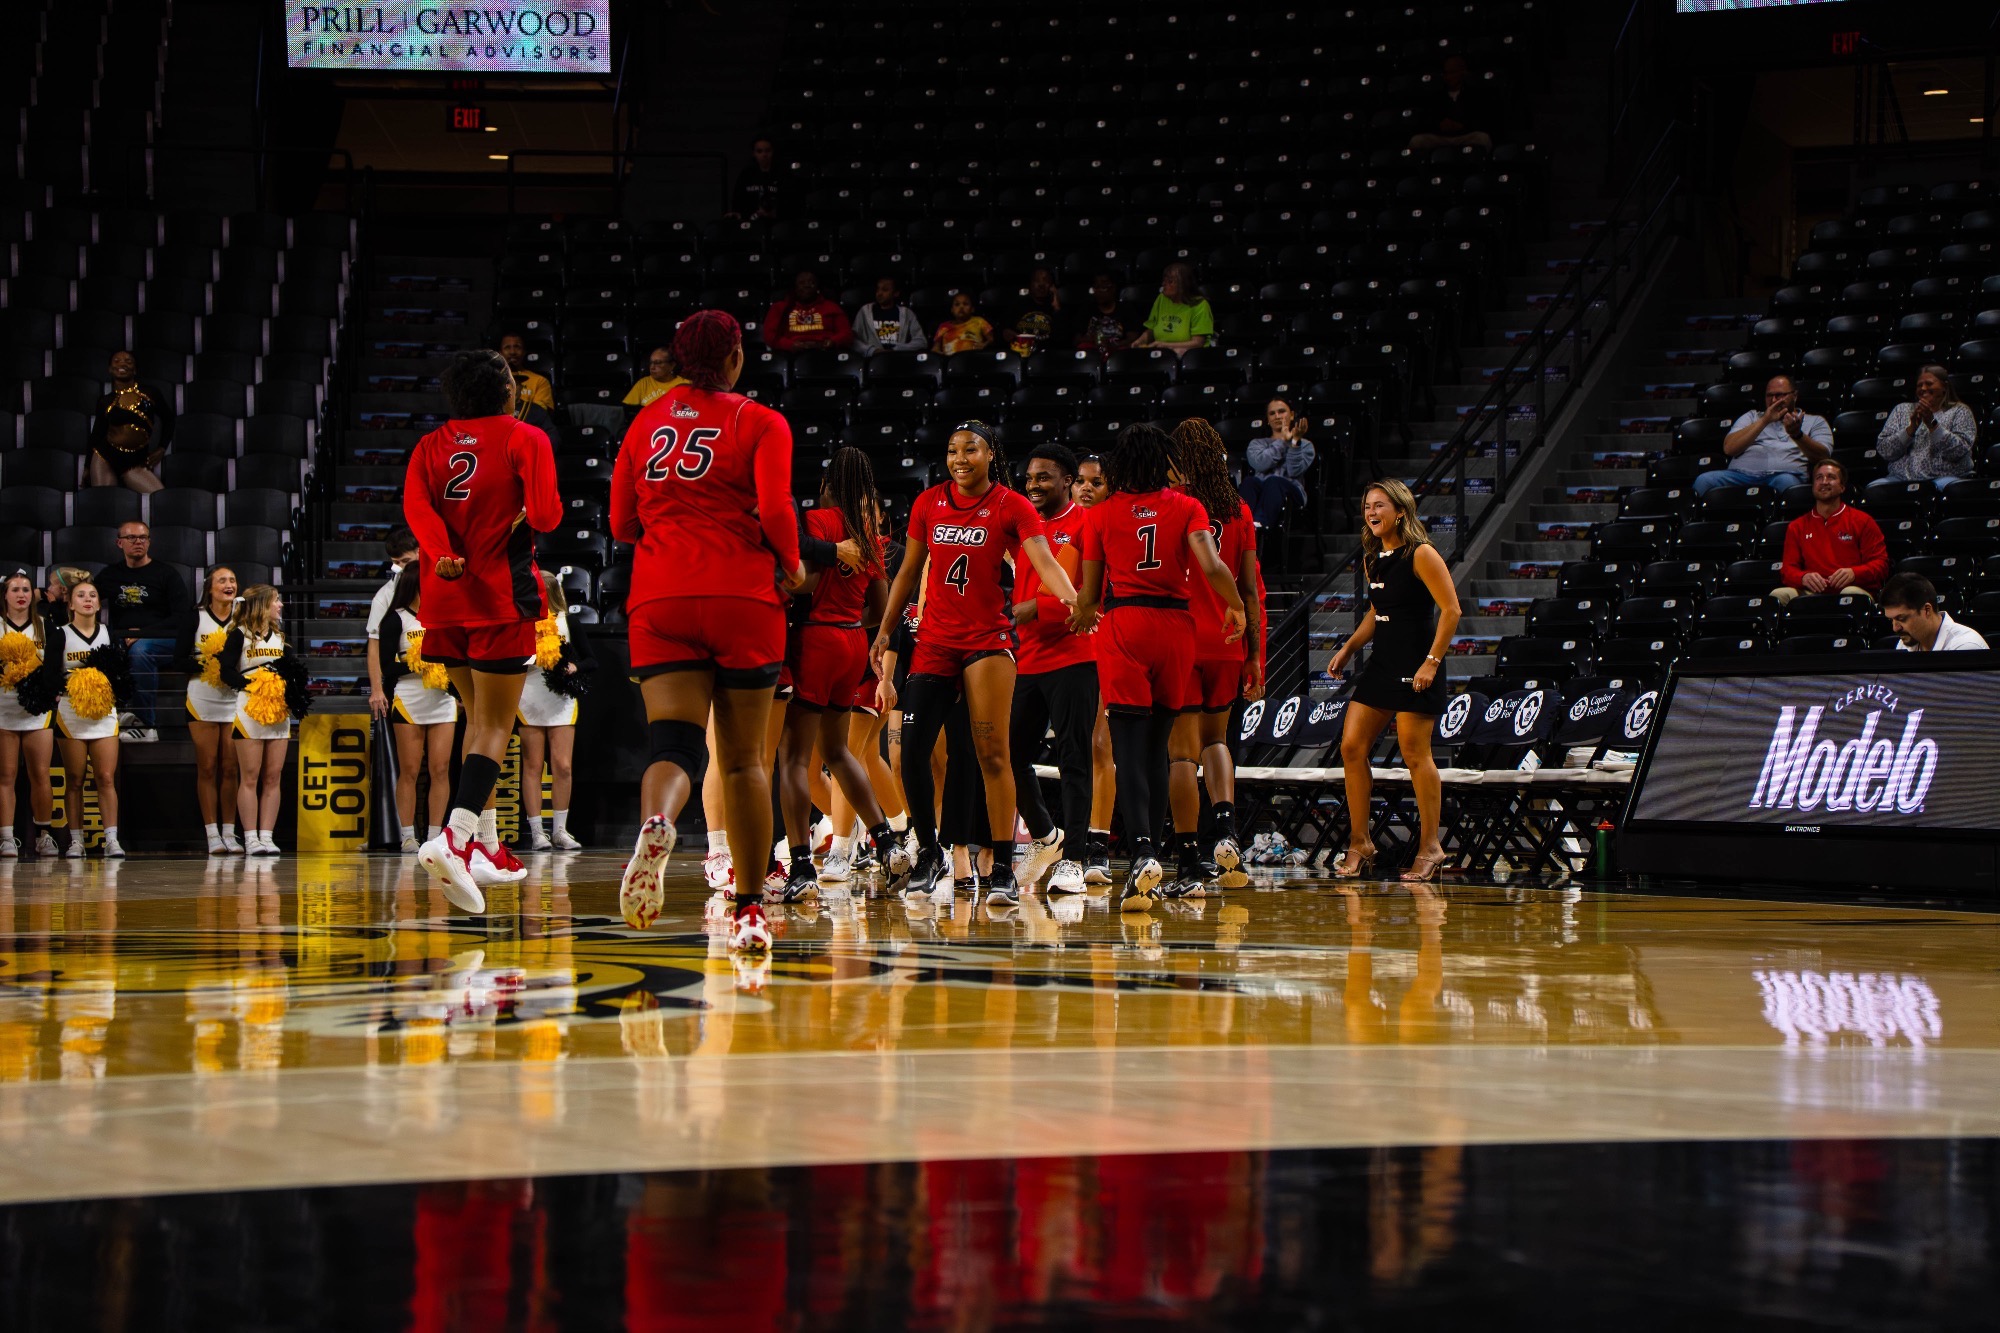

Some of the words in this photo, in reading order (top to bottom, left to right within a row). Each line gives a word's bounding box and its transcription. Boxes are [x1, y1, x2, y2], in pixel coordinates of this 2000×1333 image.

[302, 6, 395, 34] PRILL
[416, 9, 596, 36] GARWOOD
[303, 43, 448, 57] FINANCIAL
[466, 45, 597, 60] ADVISORS
[1831, 31, 1860, 55] EXIT
[453, 108, 481, 129] EXIT
[675, 409, 700, 419] SEMO
[645, 425, 722, 481] 25
[443, 451, 478, 501] 2
[933, 525, 988, 546] SEMO
[1136, 523, 1162, 572] 1
[945, 553, 970, 597] 4
[1834, 684, 1899, 714] CERVEZA
[1749, 705, 1939, 813] Modelo
[303, 756, 327, 810] GET
[330, 728, 365, 838] LOUD
[1785, 825, 1821, 833] DAKTRONICS
